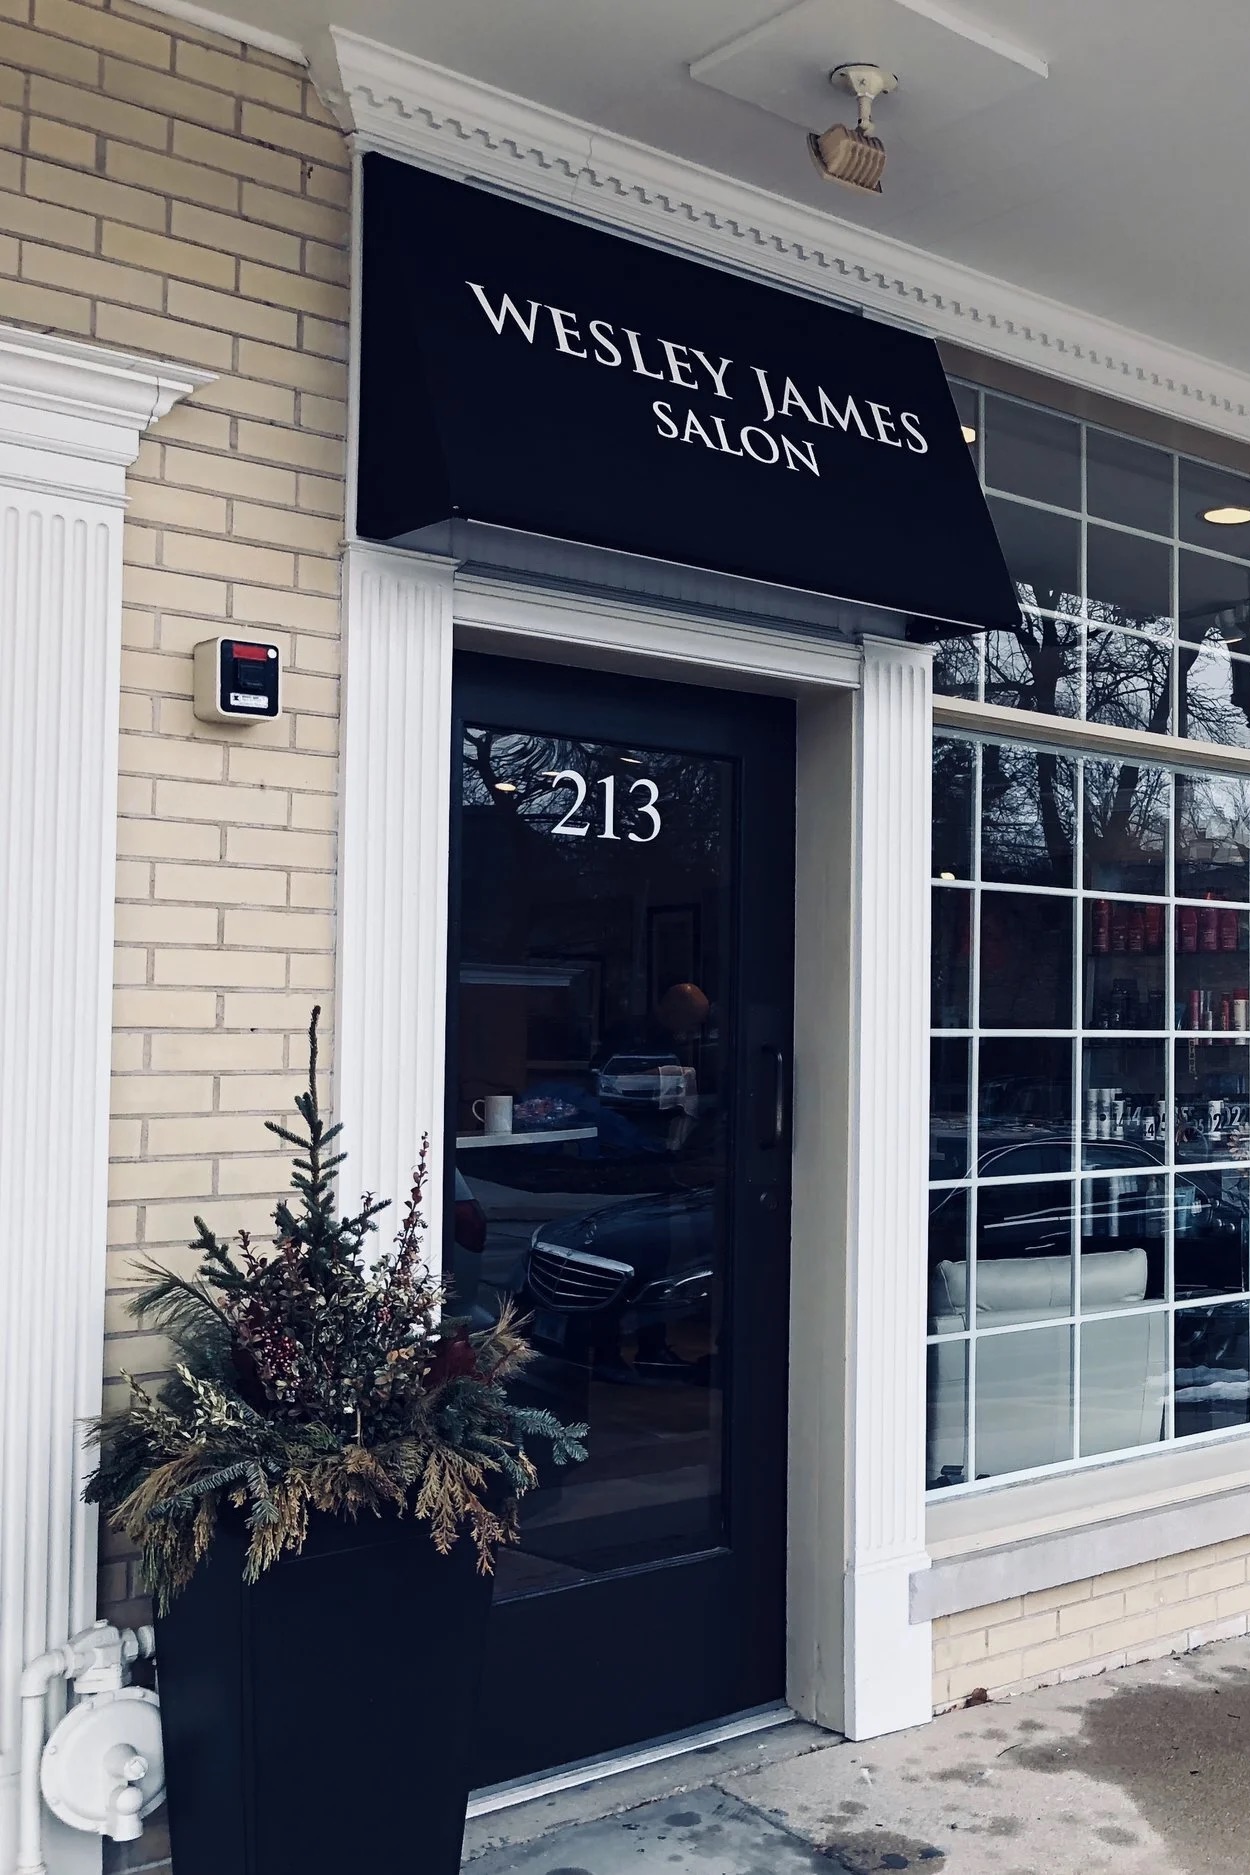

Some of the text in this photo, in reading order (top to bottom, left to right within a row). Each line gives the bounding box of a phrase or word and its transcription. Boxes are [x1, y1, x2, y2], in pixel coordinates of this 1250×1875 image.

[465, 281, 928, 454] WESLEY JAMES
[652, 401, 820, 477] SALON
[551, 769, 661, 842] 213
